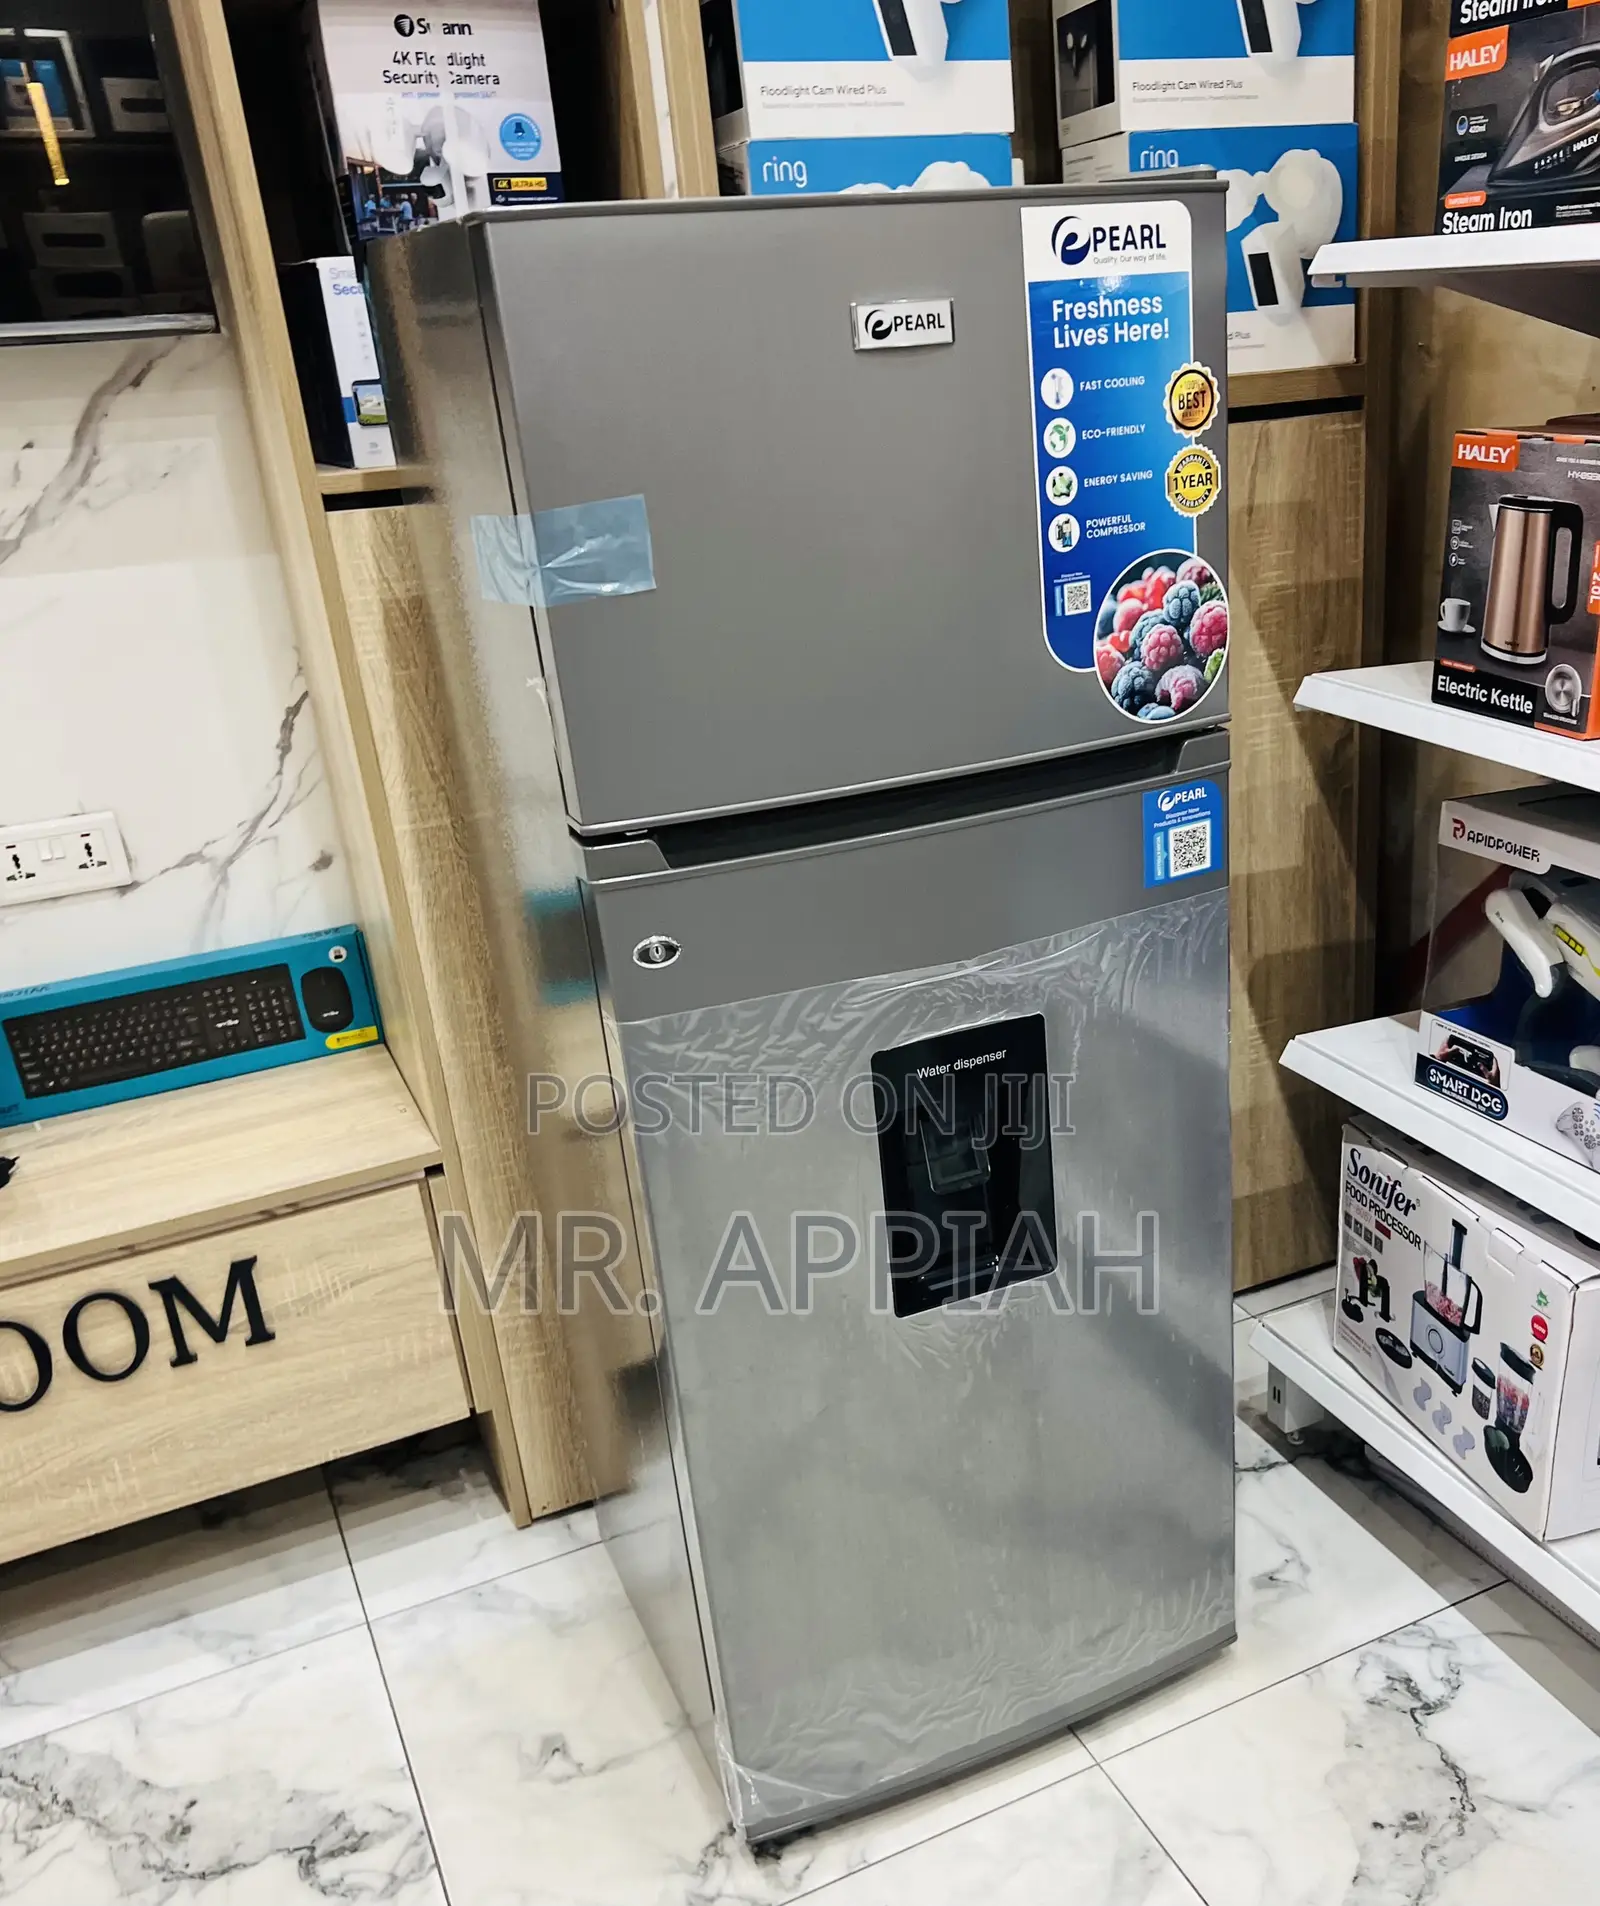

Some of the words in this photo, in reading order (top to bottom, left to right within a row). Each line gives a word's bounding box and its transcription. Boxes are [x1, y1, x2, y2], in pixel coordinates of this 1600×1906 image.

[417, 18, 472, 36] Sann
[393, 51, 412, 66] 4K
[1450, 44, 1500, 72] HALEY
[760, 86, 810, 98] Floodlight
[812, 85, 834, 96] Cam
[836, 84, 866, 95] Wired
[867, 84, 887, 95] Plus
[1132, 81, 1176, 92] Floodlight
[1178, 80, 1197, 91] Cam
[1199, 79, 1225, 90] Wired
[1226, 79, 1243, 89] Plus
[1573, 134, 1600, 152] HALEY
[762, 156, 808, 188] ring
[497, 180, 509, 189] 4K
[1442, 212, 1495, 234] Steam
[1499, 207, 1532, 230] Iron
[1133, 255, 1147, 263] way
[1053, 295, 1163, 322] Freshness
[1054, 324, 1108, 350] Lives
[1114, 319, 1170, 343] Here!
[1080, 380, 1102, 392] FAST
[1104, 376, 1145, 389] COOLING
[1178, 390, 1207, 410] BEST
[1082, 424, 1146, 440] ECO-FRIENDLY
[1177, 454, 1210, 472] WARRANTY
[1458, 444, 1511, 464] HALEY
[1084, 474, 1118, 488] ENERGY
[1120, 470, 1153, 483] SAVING
[1173, 477, 1179, 490] 1
[1180, 472, 1213, 489] YEAR
[1176, 490, 1211, 508] WARRANTY
[1086, 514, 1132, 529] POWERFUL
[1086, 523, 1146, 539] COMPRESSOR
[1437, 675, 1488, 702] Electric
[1490, 688, 1533, 714] Kettle
[1154, 818, 1177, 828] Products
[917, 1063, 951, 1079] Water
[953, 1049, 1007, 1071] dispenser
[1429, 1068, 1470, 1097] SMART
[1471, 1087, 1503, 1112] DOG
[1347, 1148, 1417, 1217] Sonifer
[1345, 1180, 1368, 1207] FOOD
[1368, 1198, 1422, 1250] PROCESSOR
